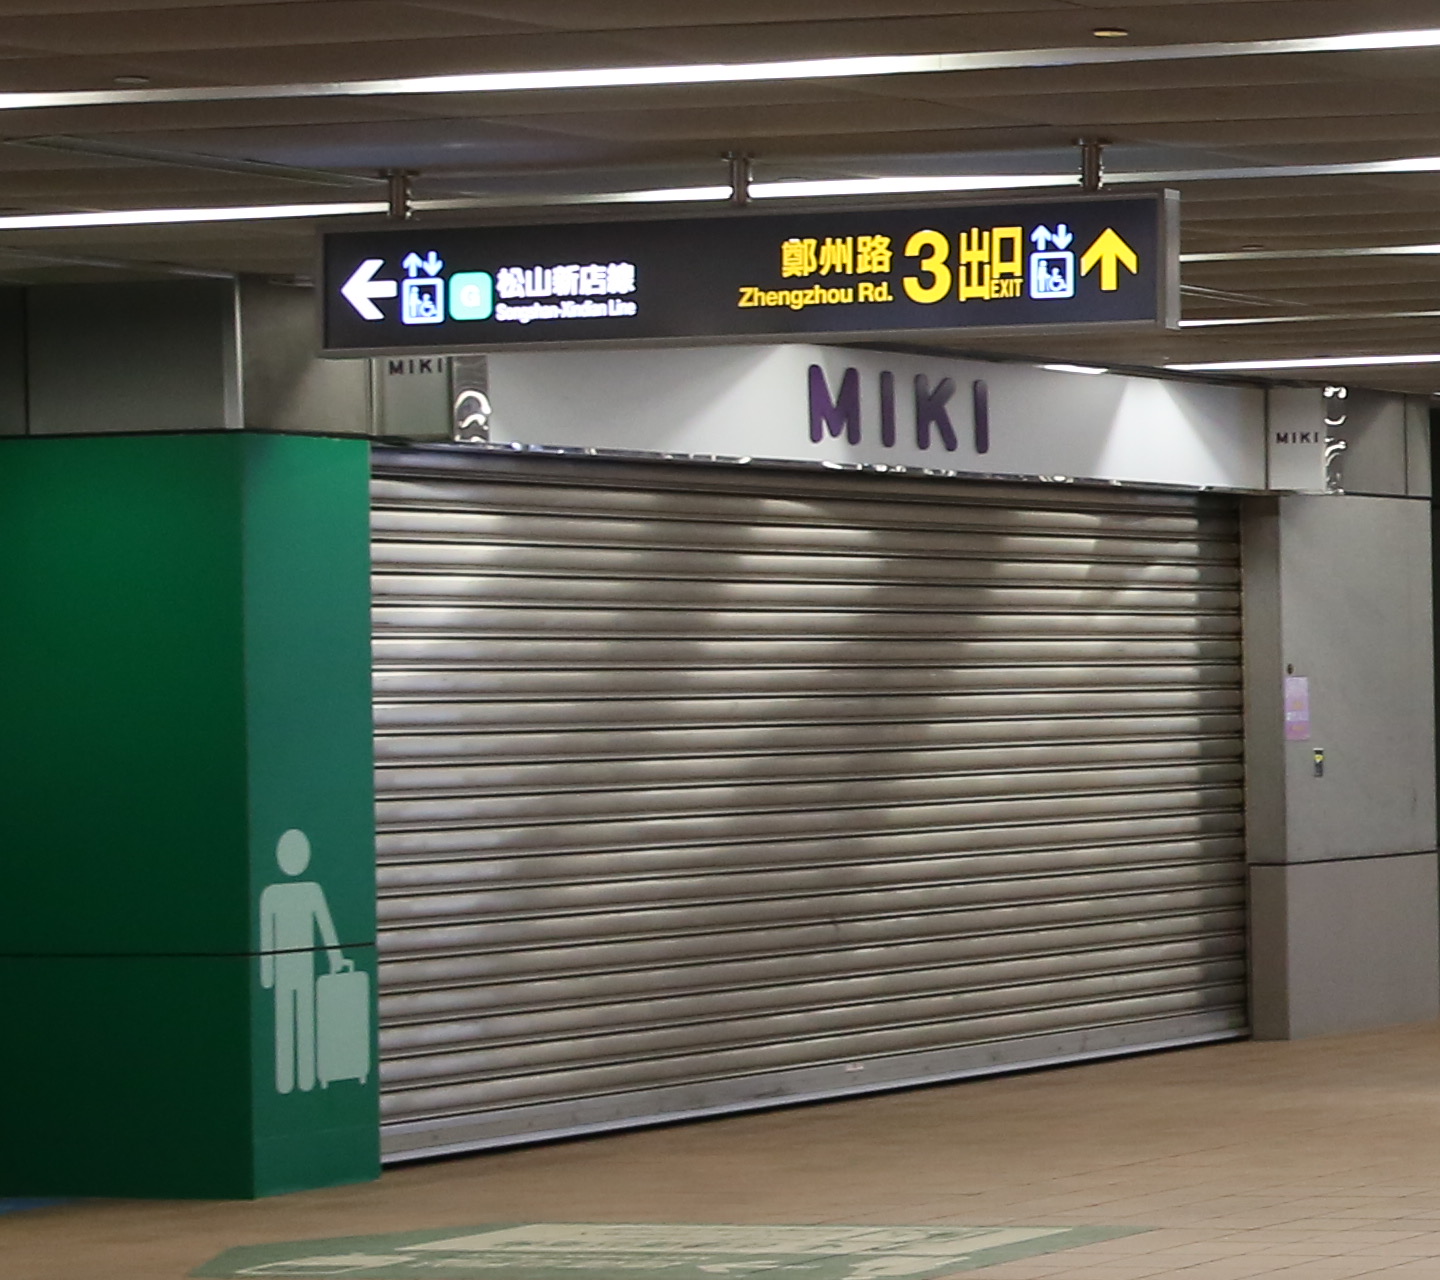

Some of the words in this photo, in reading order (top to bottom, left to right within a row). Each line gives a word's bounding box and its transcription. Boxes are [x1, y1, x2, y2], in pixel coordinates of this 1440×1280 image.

[781, 234, 893, 279] 鄭州路
[902, 230, 952, 305] 3
[959, 226, 1023, 302] 出口
[497, 263, 637, 299] 松山新店線
[737, 284, 854, 310] Zhengzhou
[858, 282, 894, 304] Rd.
[991, 278, 1024, 298] EXIT
[608, 299, 638, 317] Line
[388, 357, 444, 376] MIKI
[808, 363, 990, 454] MIKI
[1276, 432, 1319, 443] MIKI
